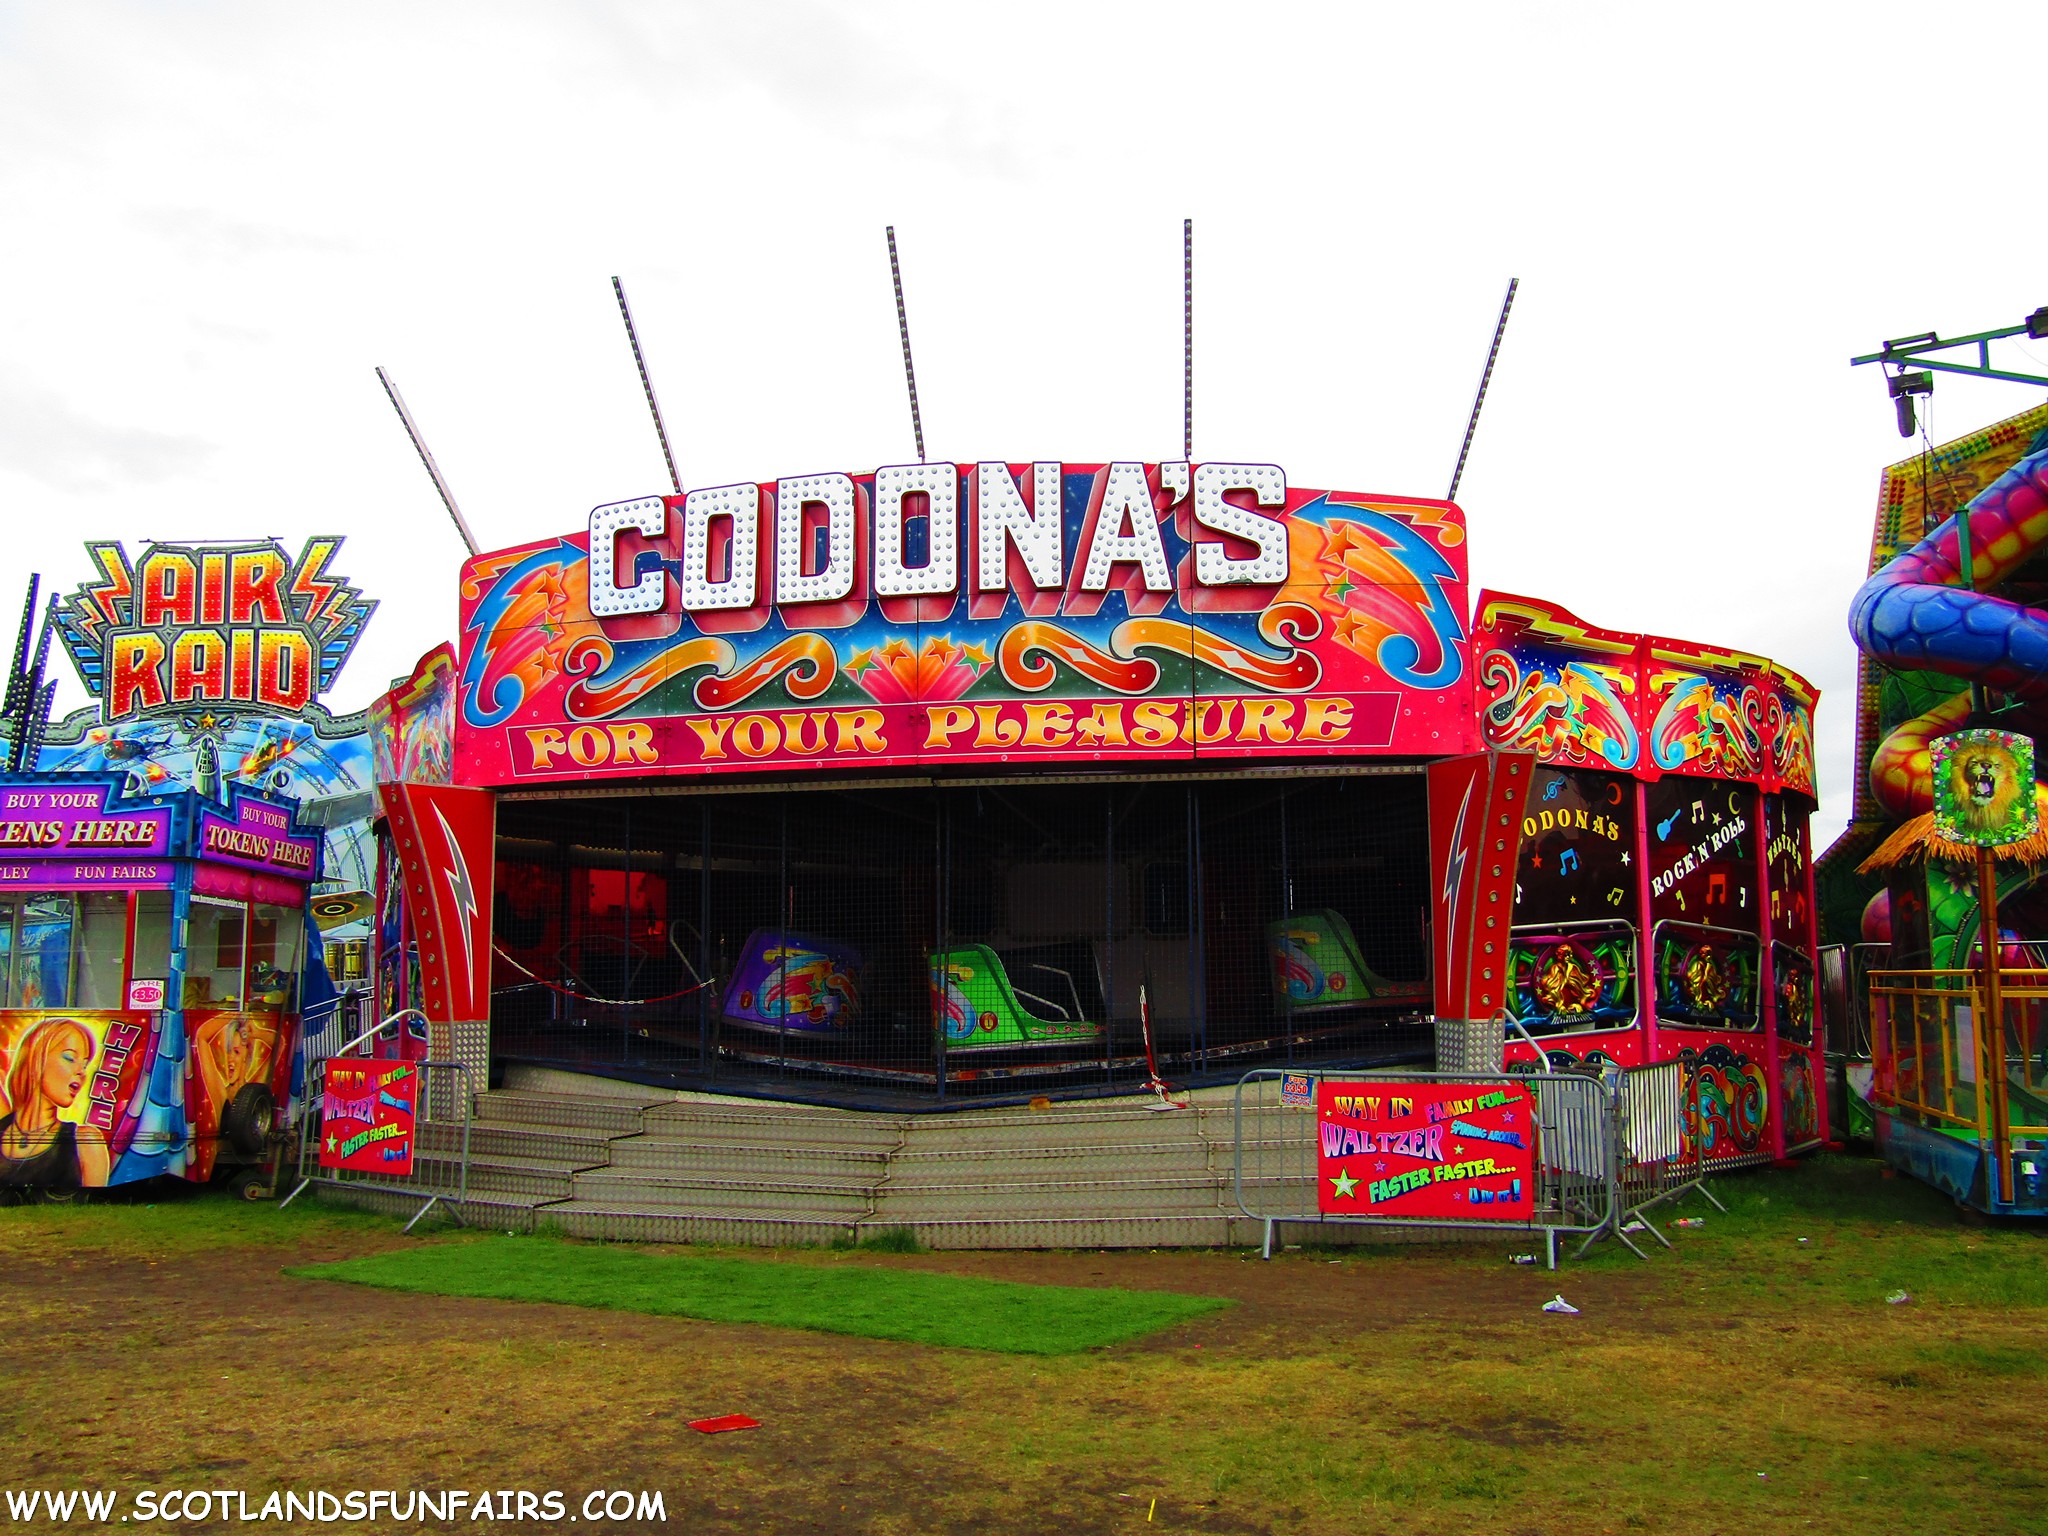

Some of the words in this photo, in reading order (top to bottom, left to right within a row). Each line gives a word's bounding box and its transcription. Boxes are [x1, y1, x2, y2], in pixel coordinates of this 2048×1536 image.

[588, 461, 1289, 618] CODONA'S
[142, 550, 287, 626] AIR
[109, 628, 315, 719] RAID
[525, 721, 659, 769] FOR
[686, 709, 888, 761] YOUR
[923, 697, 1354, 749] PLEASURE
[6, 795, 45, 808] BUY
[49, 793, 98, 808] YOUR
[68, 820, 157, 846] HERE
[242, 806, 261, 823] BUY
[263, 811, 287, 830] YOUR
[1520, 808, 1618, 844] ODONA'S
[207, 824, 270, 860] TOKENS
[271, 839, 312, 868] HERE
[74, 866, 105, 879] FUN
[112, 866, 157, 879] FAIRS
[134, 990, 161, 1000] £3.50
[85, 1020, 142, 1130] HERE
[323, 1091, 375, 1125] WALTZER
[1333, 1096, 1381, 1121] WAY
[1390, 1097, 1413, 1119] IN
[1424, 1098, 1474, 1124] FAMILY
[341, 1130, 369, 1160] FASTER
[1320, 1120, 1444, 1162] WALTZER
[1369, 1167, 1432, 1205] FASTER
[1469, 1187, 1480, 1204] U
